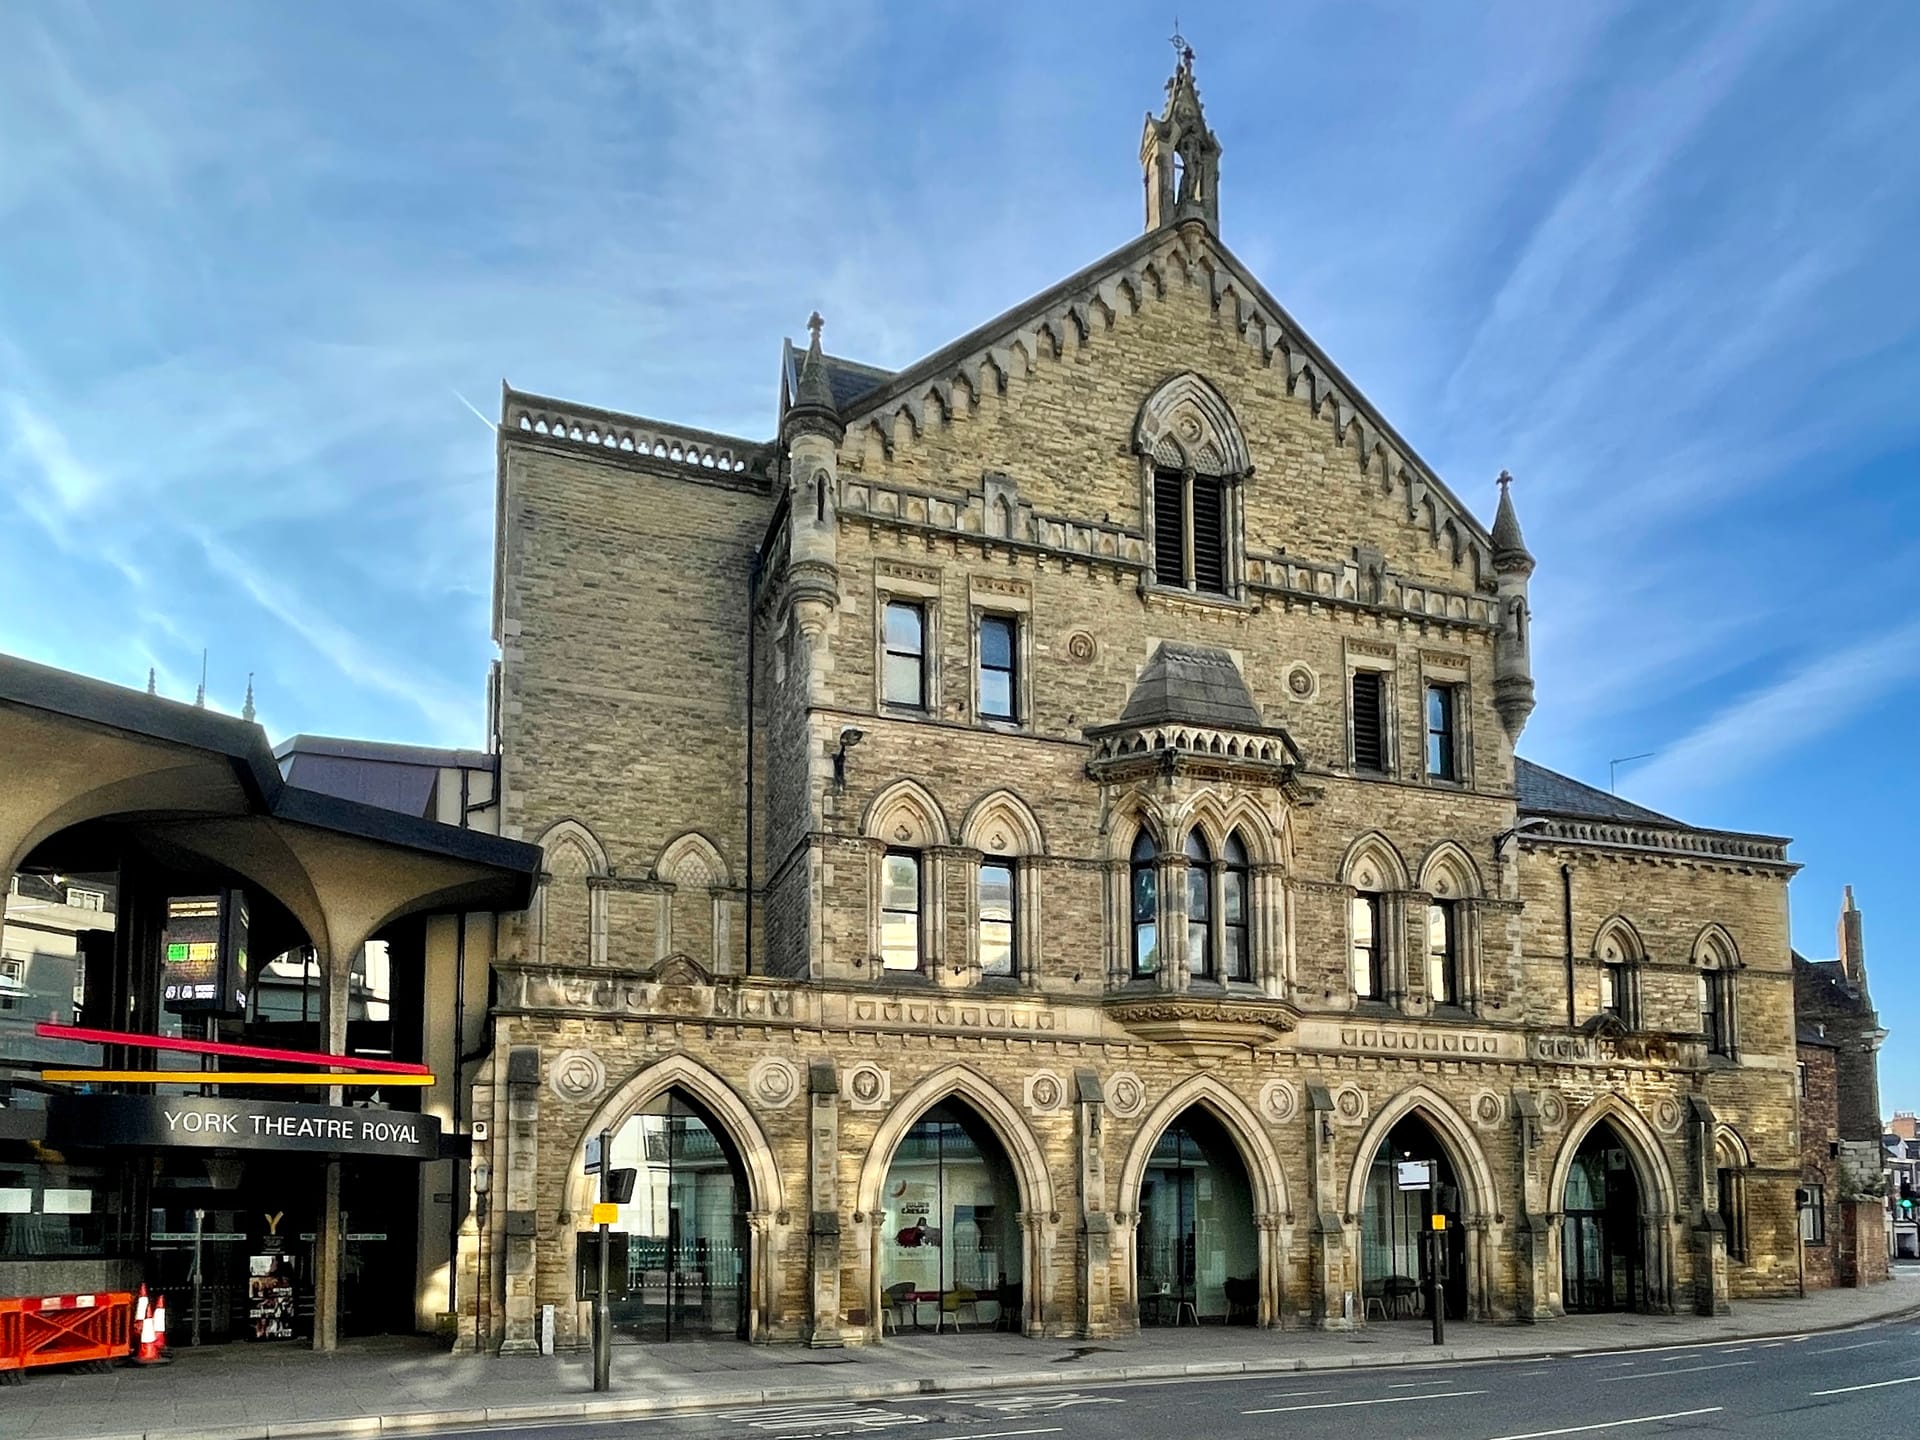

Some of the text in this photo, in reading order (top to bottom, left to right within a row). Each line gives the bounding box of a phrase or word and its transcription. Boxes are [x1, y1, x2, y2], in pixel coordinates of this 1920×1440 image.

[164, 1111, 420, 1144] YORK THEATRE ROYAL
